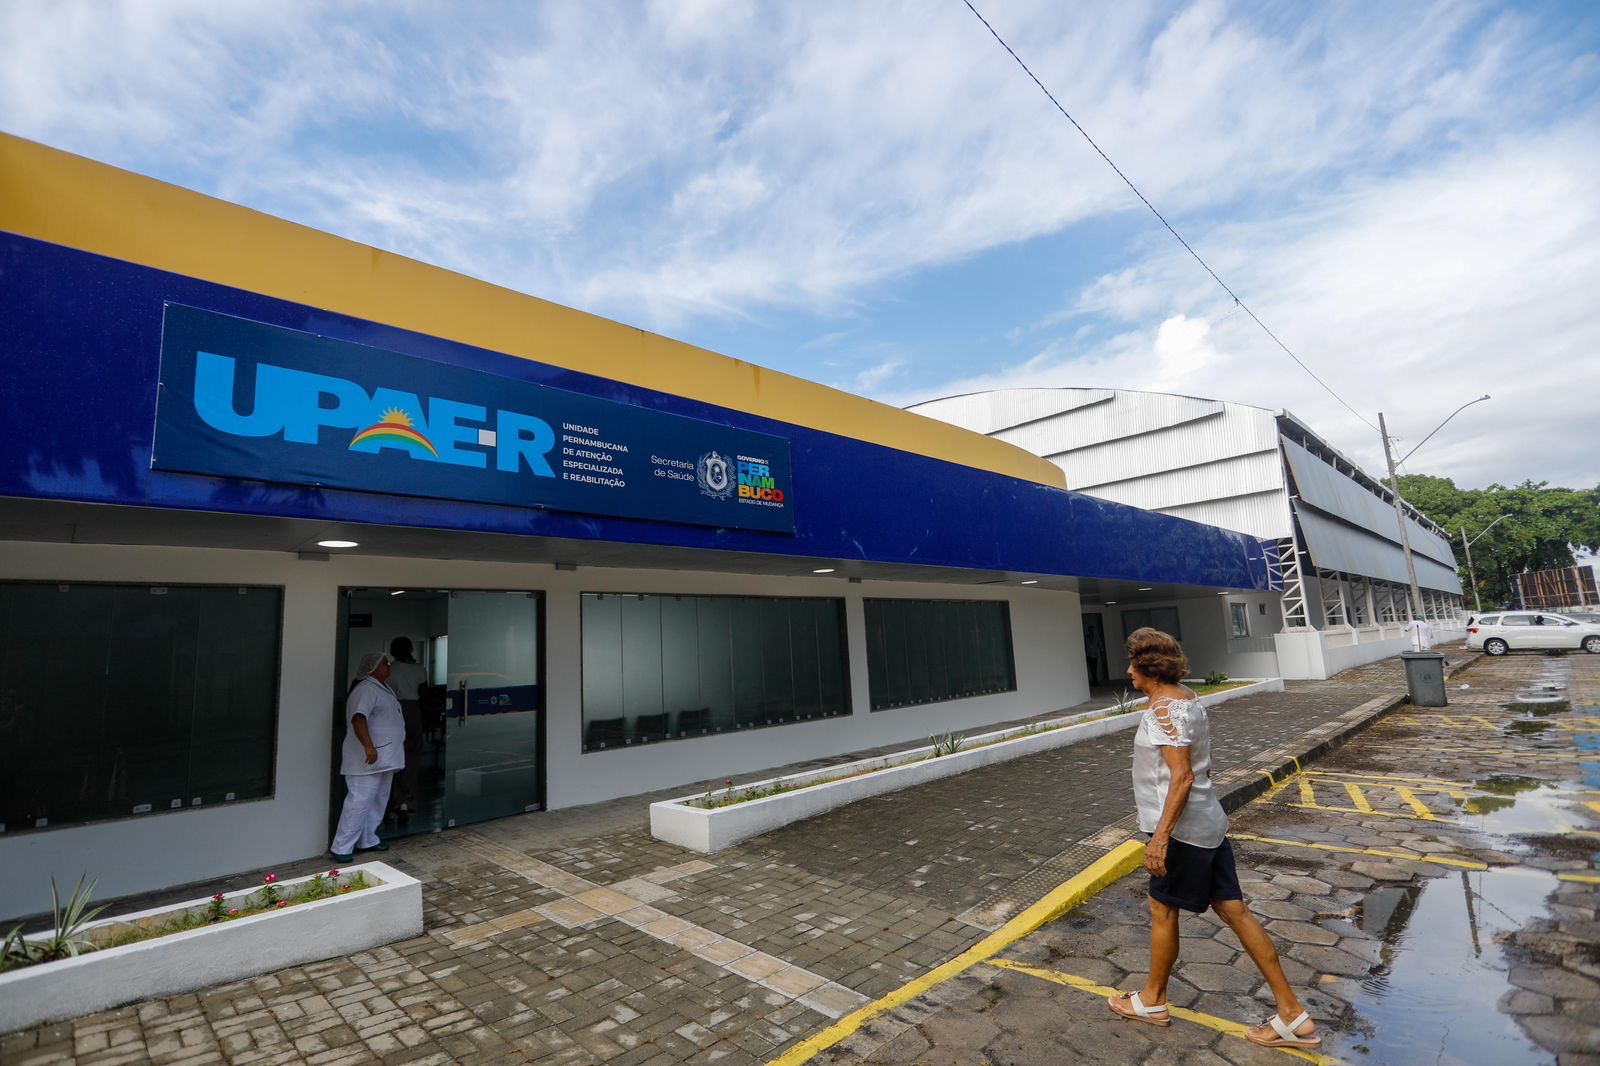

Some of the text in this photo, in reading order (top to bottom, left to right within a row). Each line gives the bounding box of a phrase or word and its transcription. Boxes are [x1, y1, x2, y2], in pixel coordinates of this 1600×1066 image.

[562, 422, 599, 435] UNIDADE
[562, 434, 628, 452] PERNAMBUCANA
[563, 447, 612, 462] DE ATENÇÃO
[737, 455, 765, 464] GOVERNO
[563, 460, 623, 475] ESPECIALIZADA
[651, 455, 694, 470] Secretaria
[737, 461, 769, 477] PER
[563, 472, 625, 487] E REABILITAÇÃO
[654, 468, 694, 481] de Saúde
[738, 472, 774, 489] NAM
[738, 484, 784, 502] BUCO
